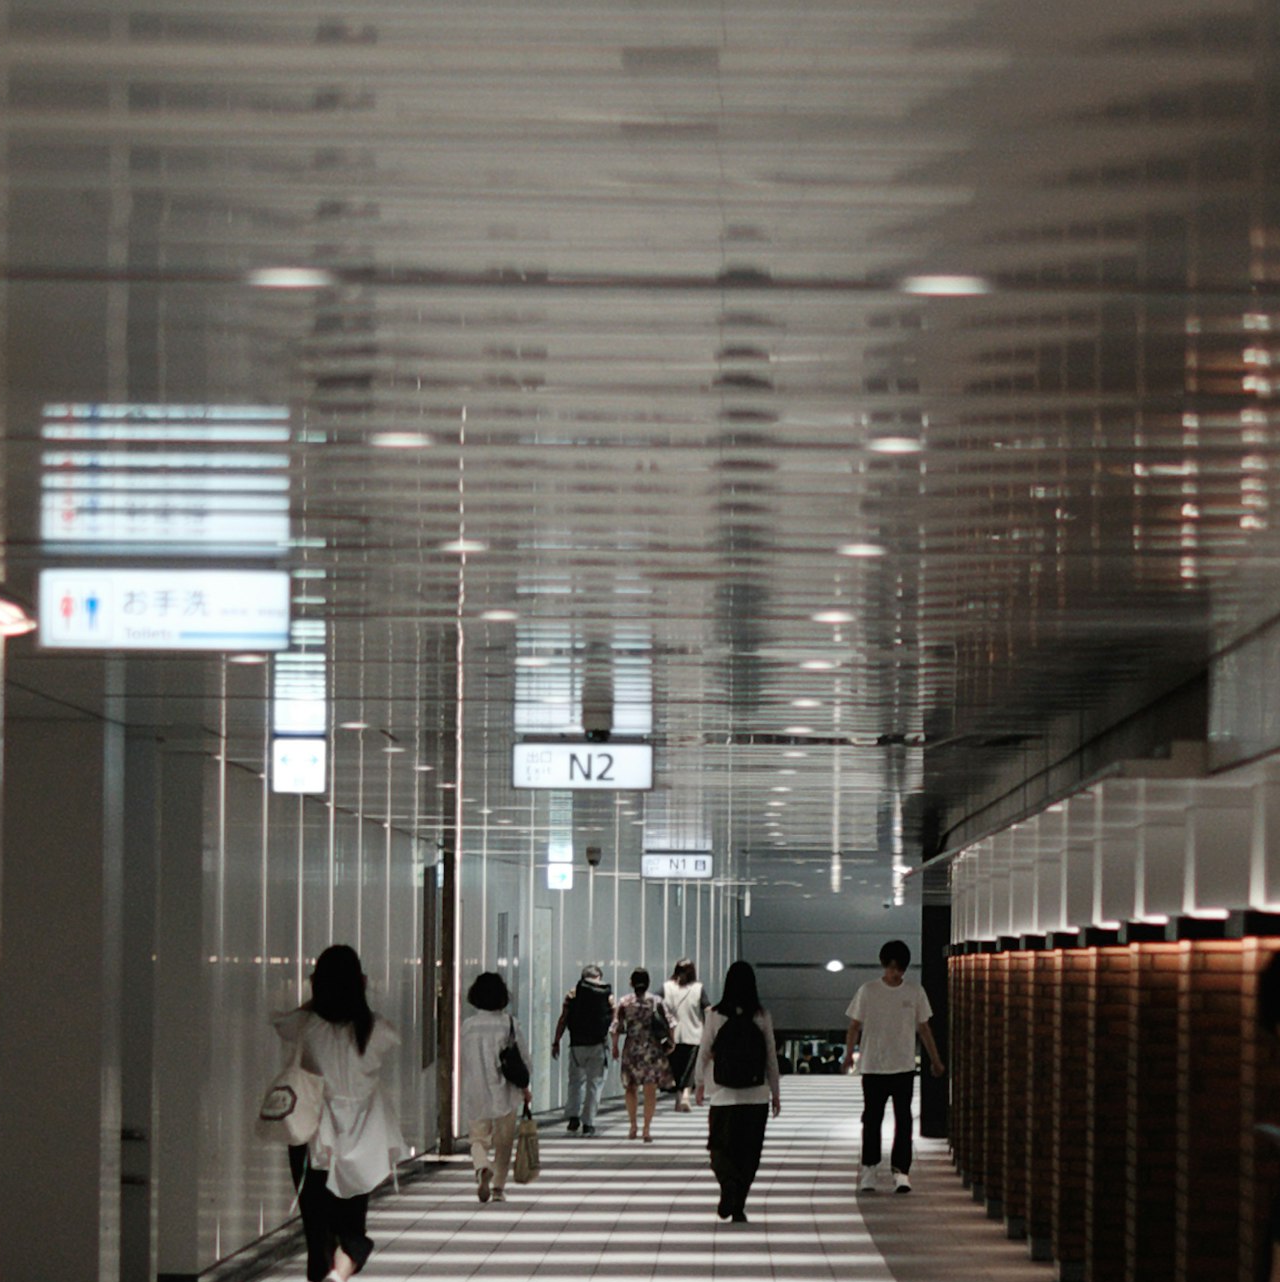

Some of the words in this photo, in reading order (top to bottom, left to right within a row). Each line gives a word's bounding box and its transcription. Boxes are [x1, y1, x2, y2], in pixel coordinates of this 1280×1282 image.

[123, 590, 209, 616] お手洗
[125, 627, 172, 640] Toilets
[526, 751, 552, 764] 出口
[569, 752, 615, 781] N2
[669, 858, 686, 870] N1
